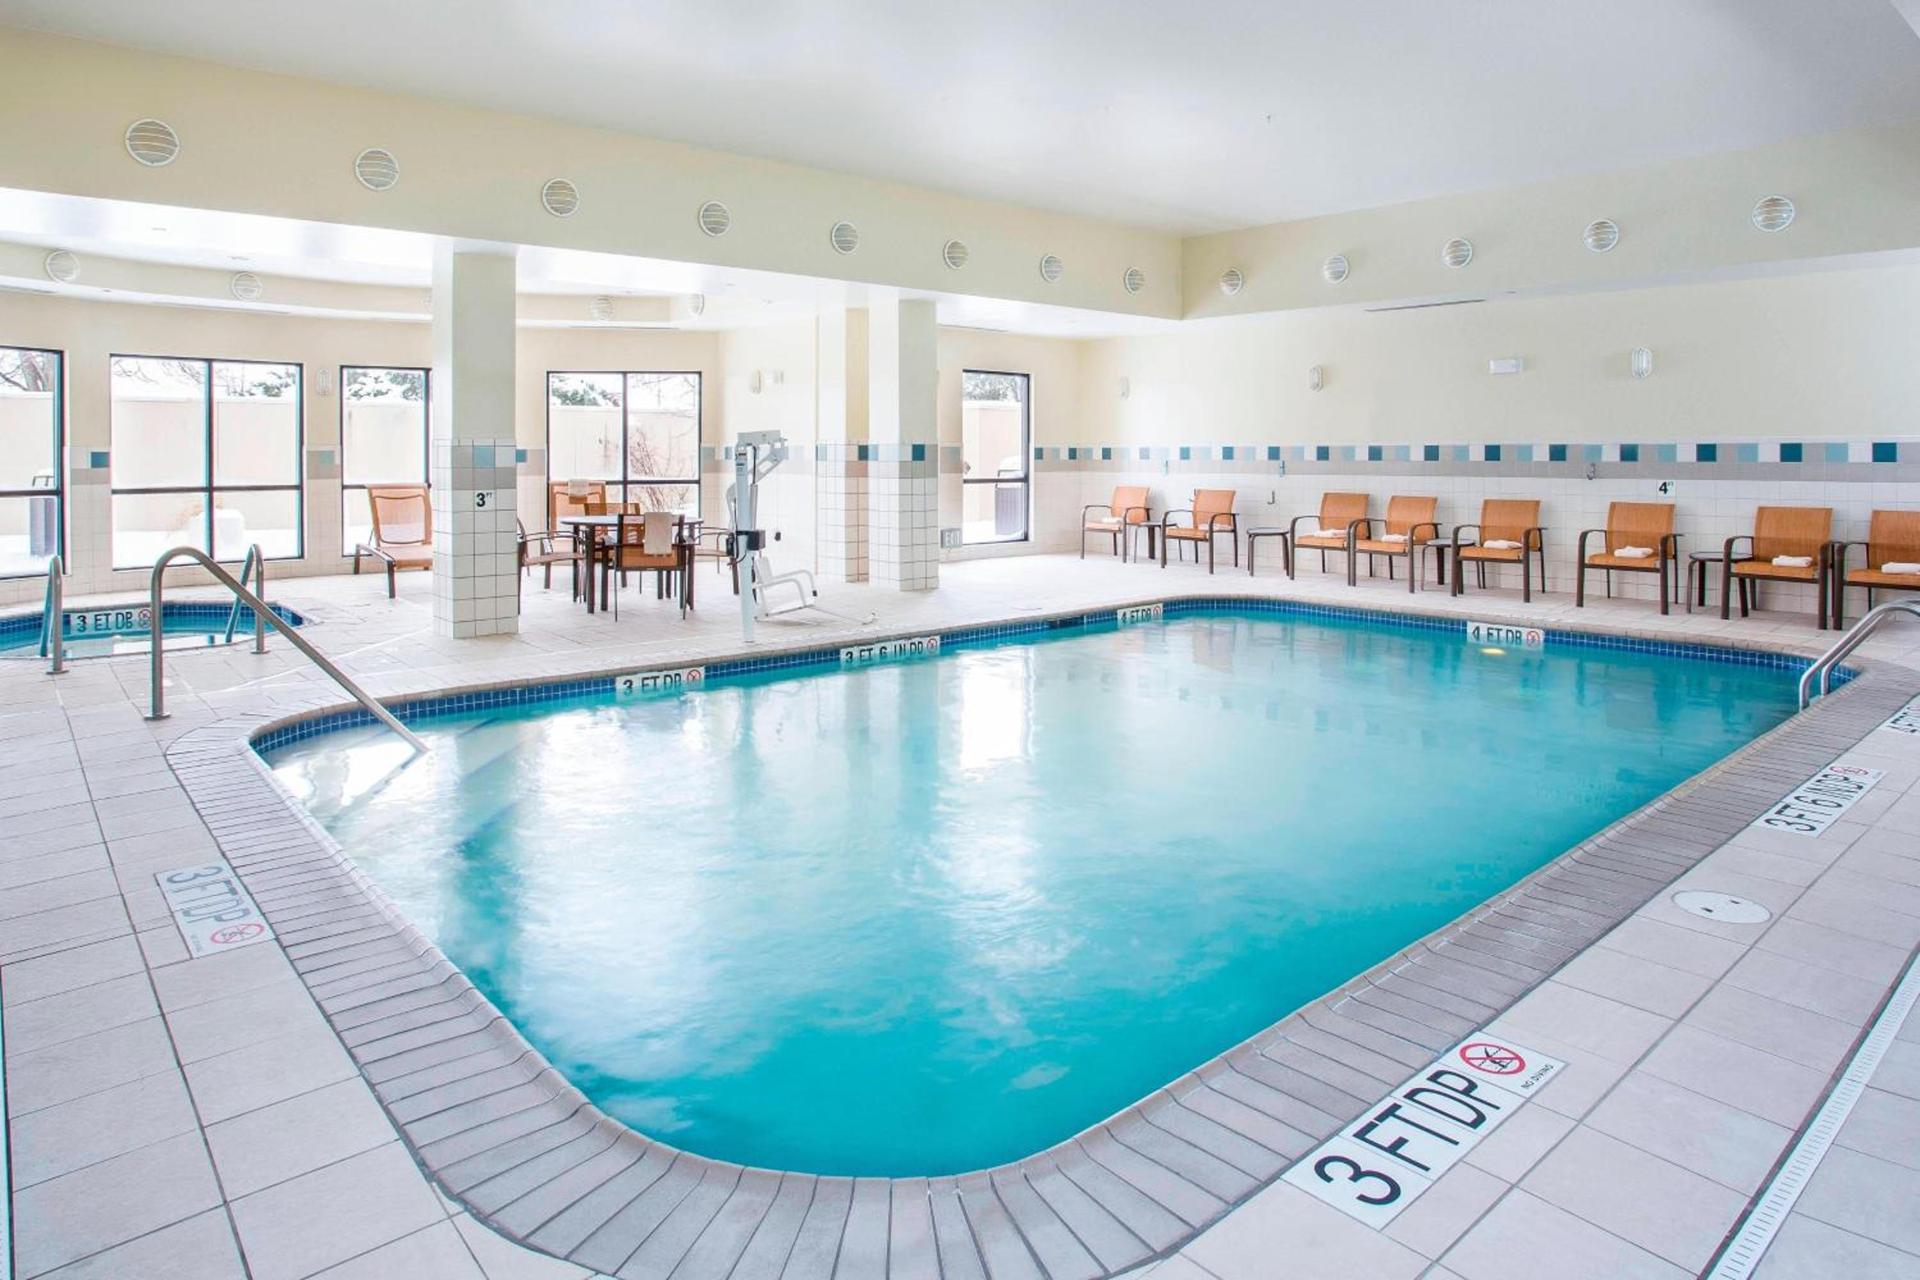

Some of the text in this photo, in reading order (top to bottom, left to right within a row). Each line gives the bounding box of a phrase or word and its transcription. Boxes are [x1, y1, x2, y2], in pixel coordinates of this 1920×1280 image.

[77, 615, 87, 632] 3
[1472, 626, 1480, 641] 4
[623, 679, 634, 695] 3
[1764, 818, 1816, 832] 3
[167, 866, 223, 883] 3
[1314, 1155, 1401, 1206] 3
